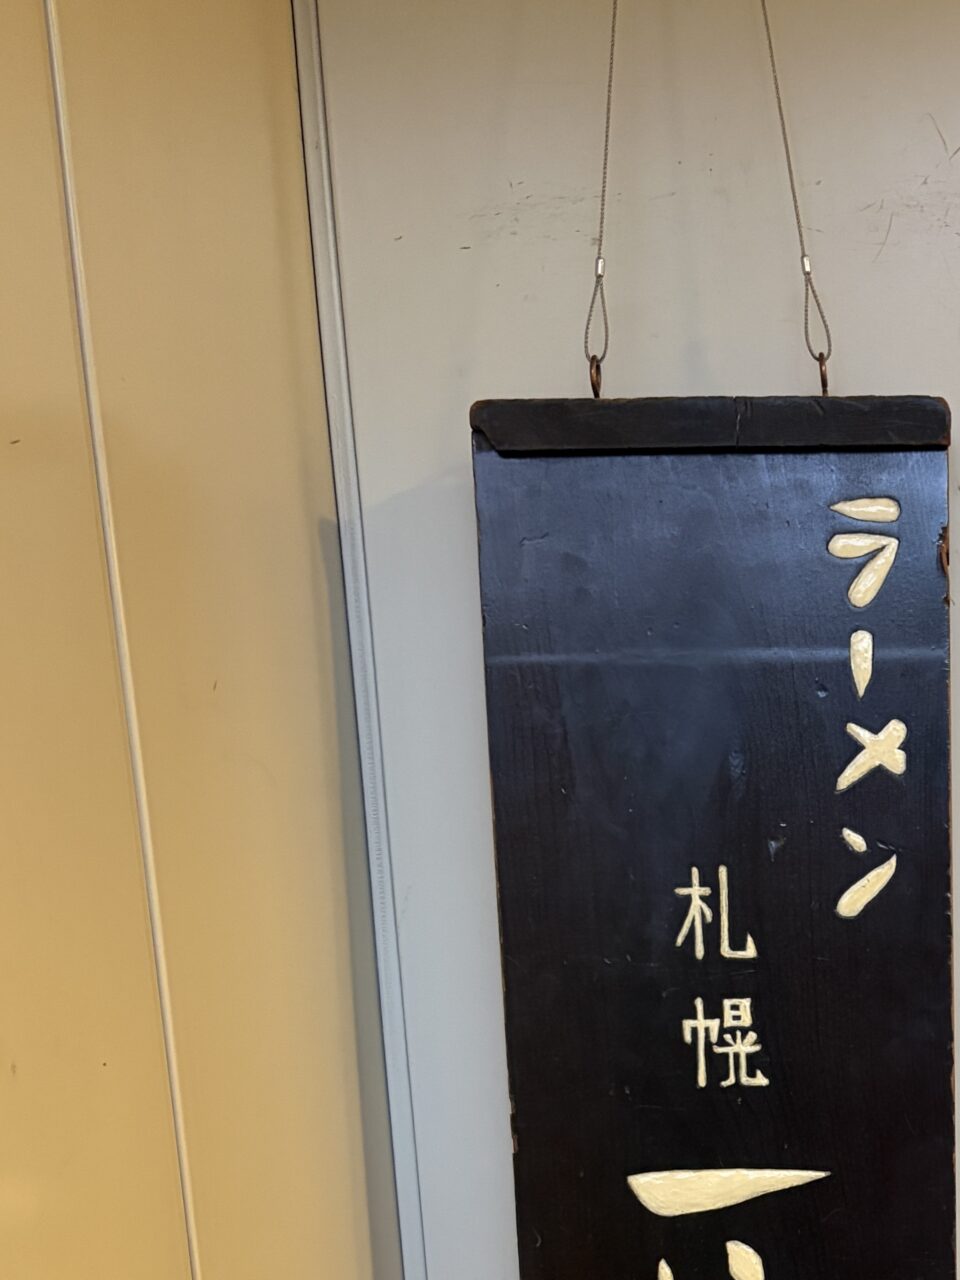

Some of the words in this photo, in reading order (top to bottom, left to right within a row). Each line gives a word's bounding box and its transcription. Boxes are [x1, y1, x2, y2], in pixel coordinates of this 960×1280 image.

[827, 497, 907, 918] ラーメン
[674, 864, 769, 1088] 札幌
